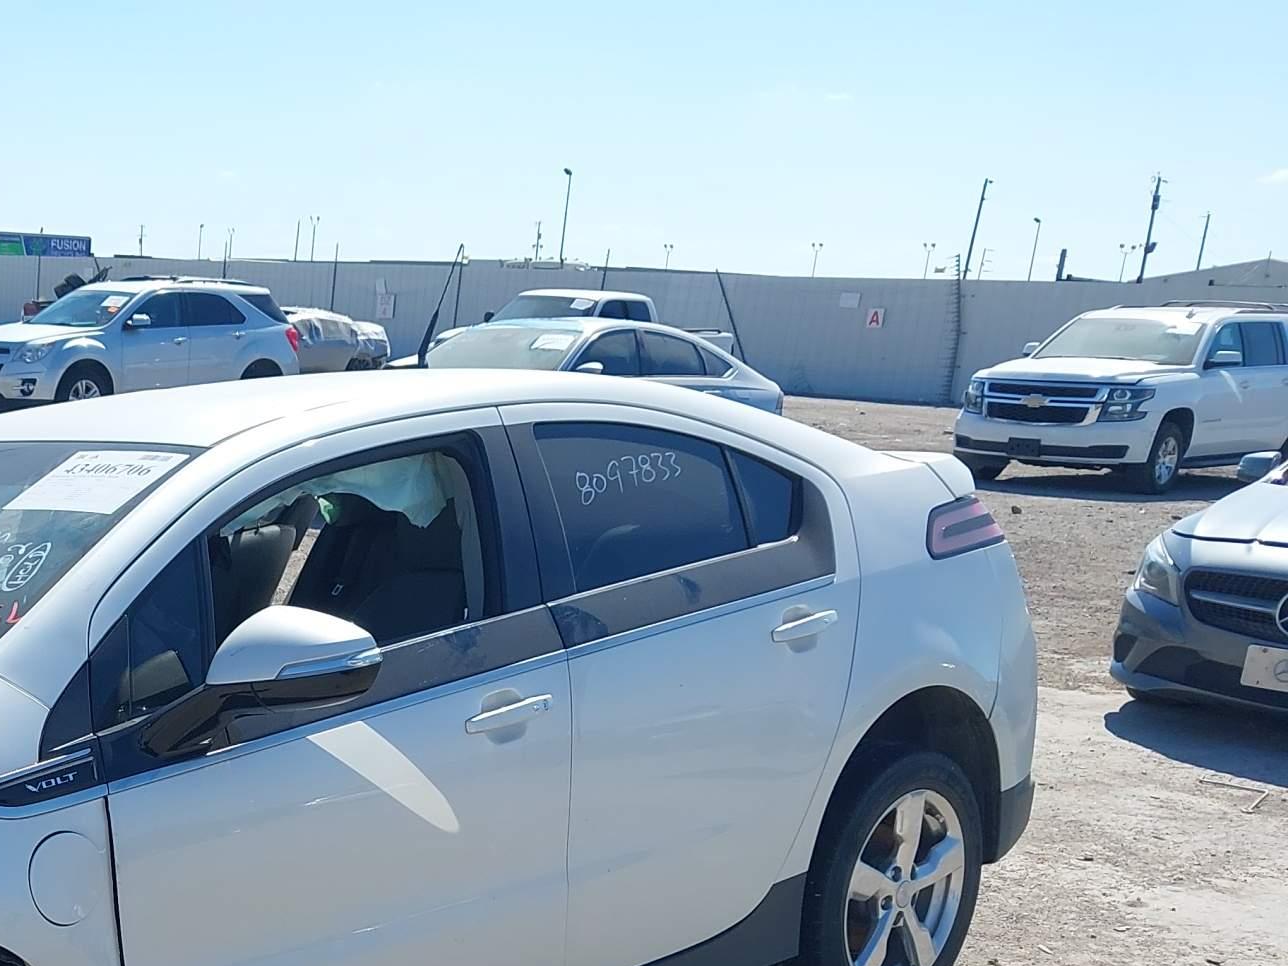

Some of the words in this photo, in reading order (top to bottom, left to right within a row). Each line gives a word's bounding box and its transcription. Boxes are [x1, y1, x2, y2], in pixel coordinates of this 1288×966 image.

[51, 238, 86, 251] FUSION
[868, 311, 880, 326] A
[64, 463, 153, 476] 43406706
[575, 452, 681, 505] 8097833
[25, 772, 77, 792] VOLT
